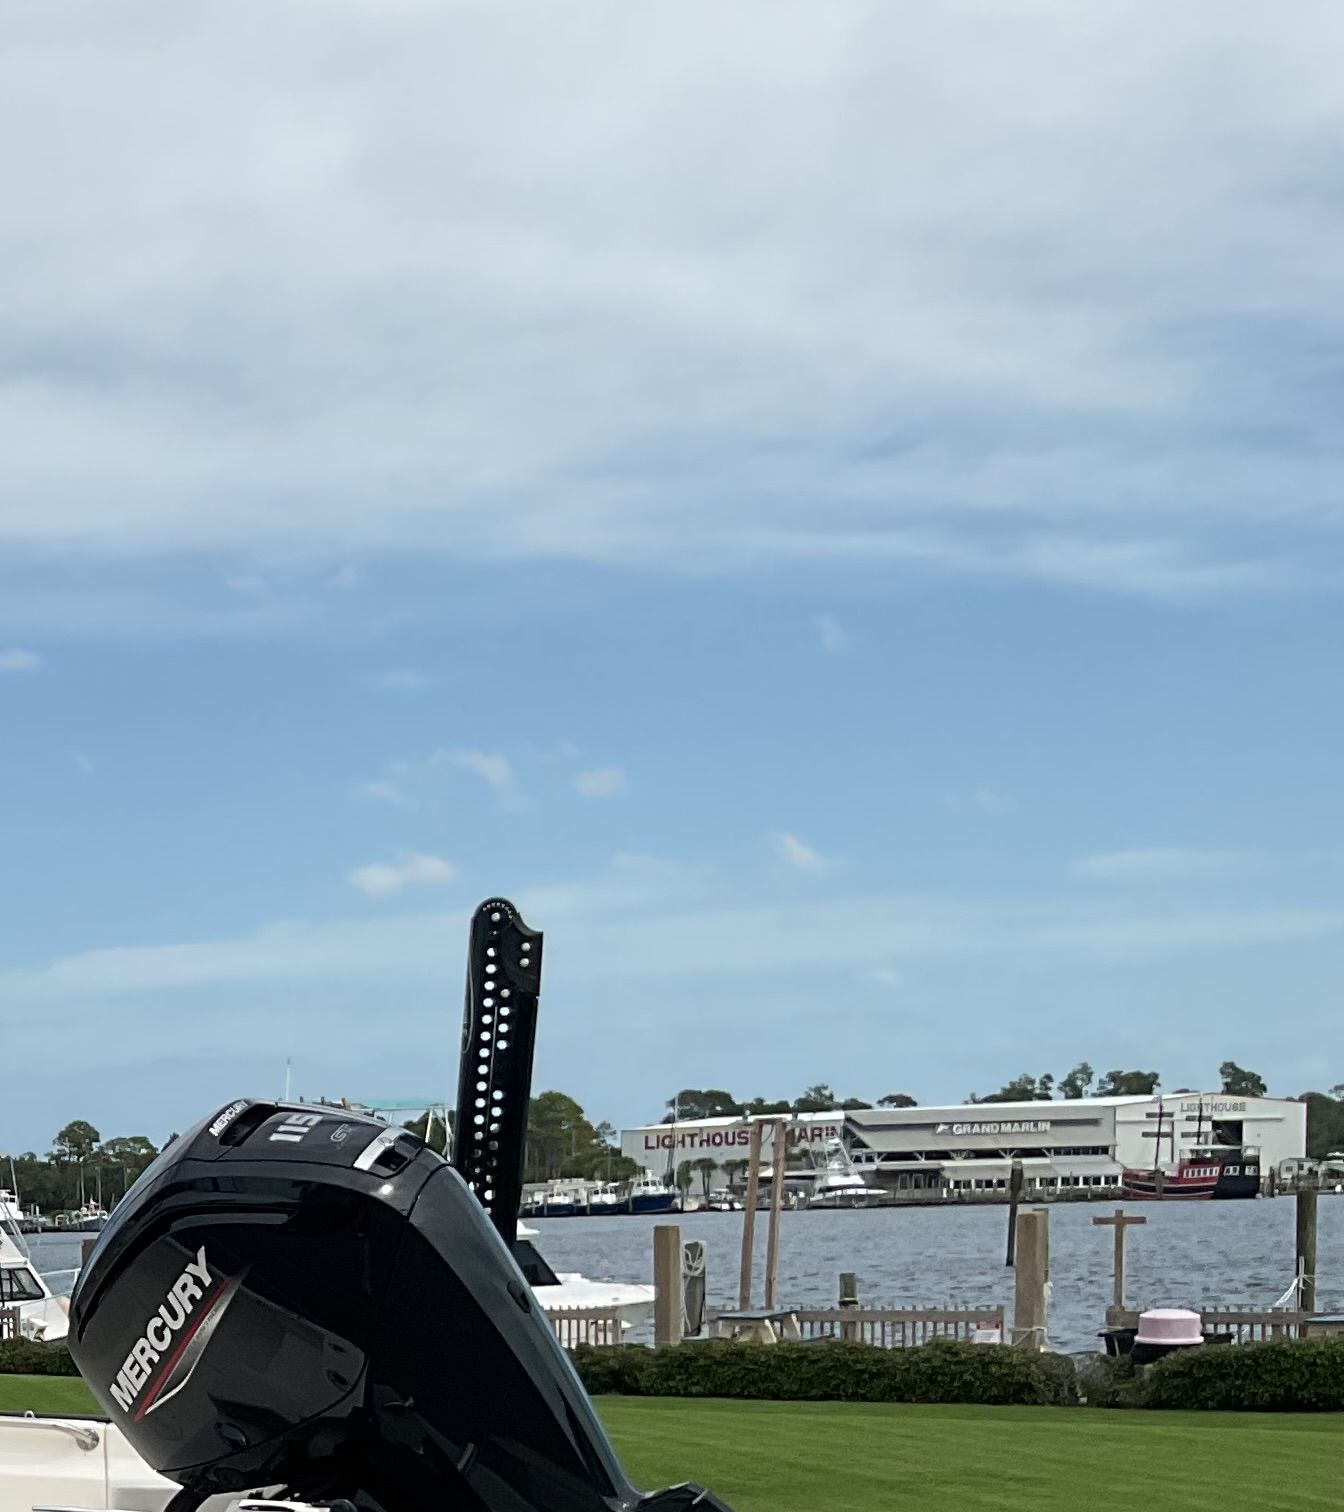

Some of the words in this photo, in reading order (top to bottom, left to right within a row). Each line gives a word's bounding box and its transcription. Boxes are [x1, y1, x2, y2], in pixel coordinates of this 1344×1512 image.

[209, 1099, 250, 1137] MERCURY
[269, 1112, 324, 1143] 115
[952, 1122, 999, 1135] GRAND
[1000, 1120, 1051, 1133] MARLIN
[644, 1129, 751, 1151] LIGHTHOUS
[108, 1244, 213, 1413] MERCURY
